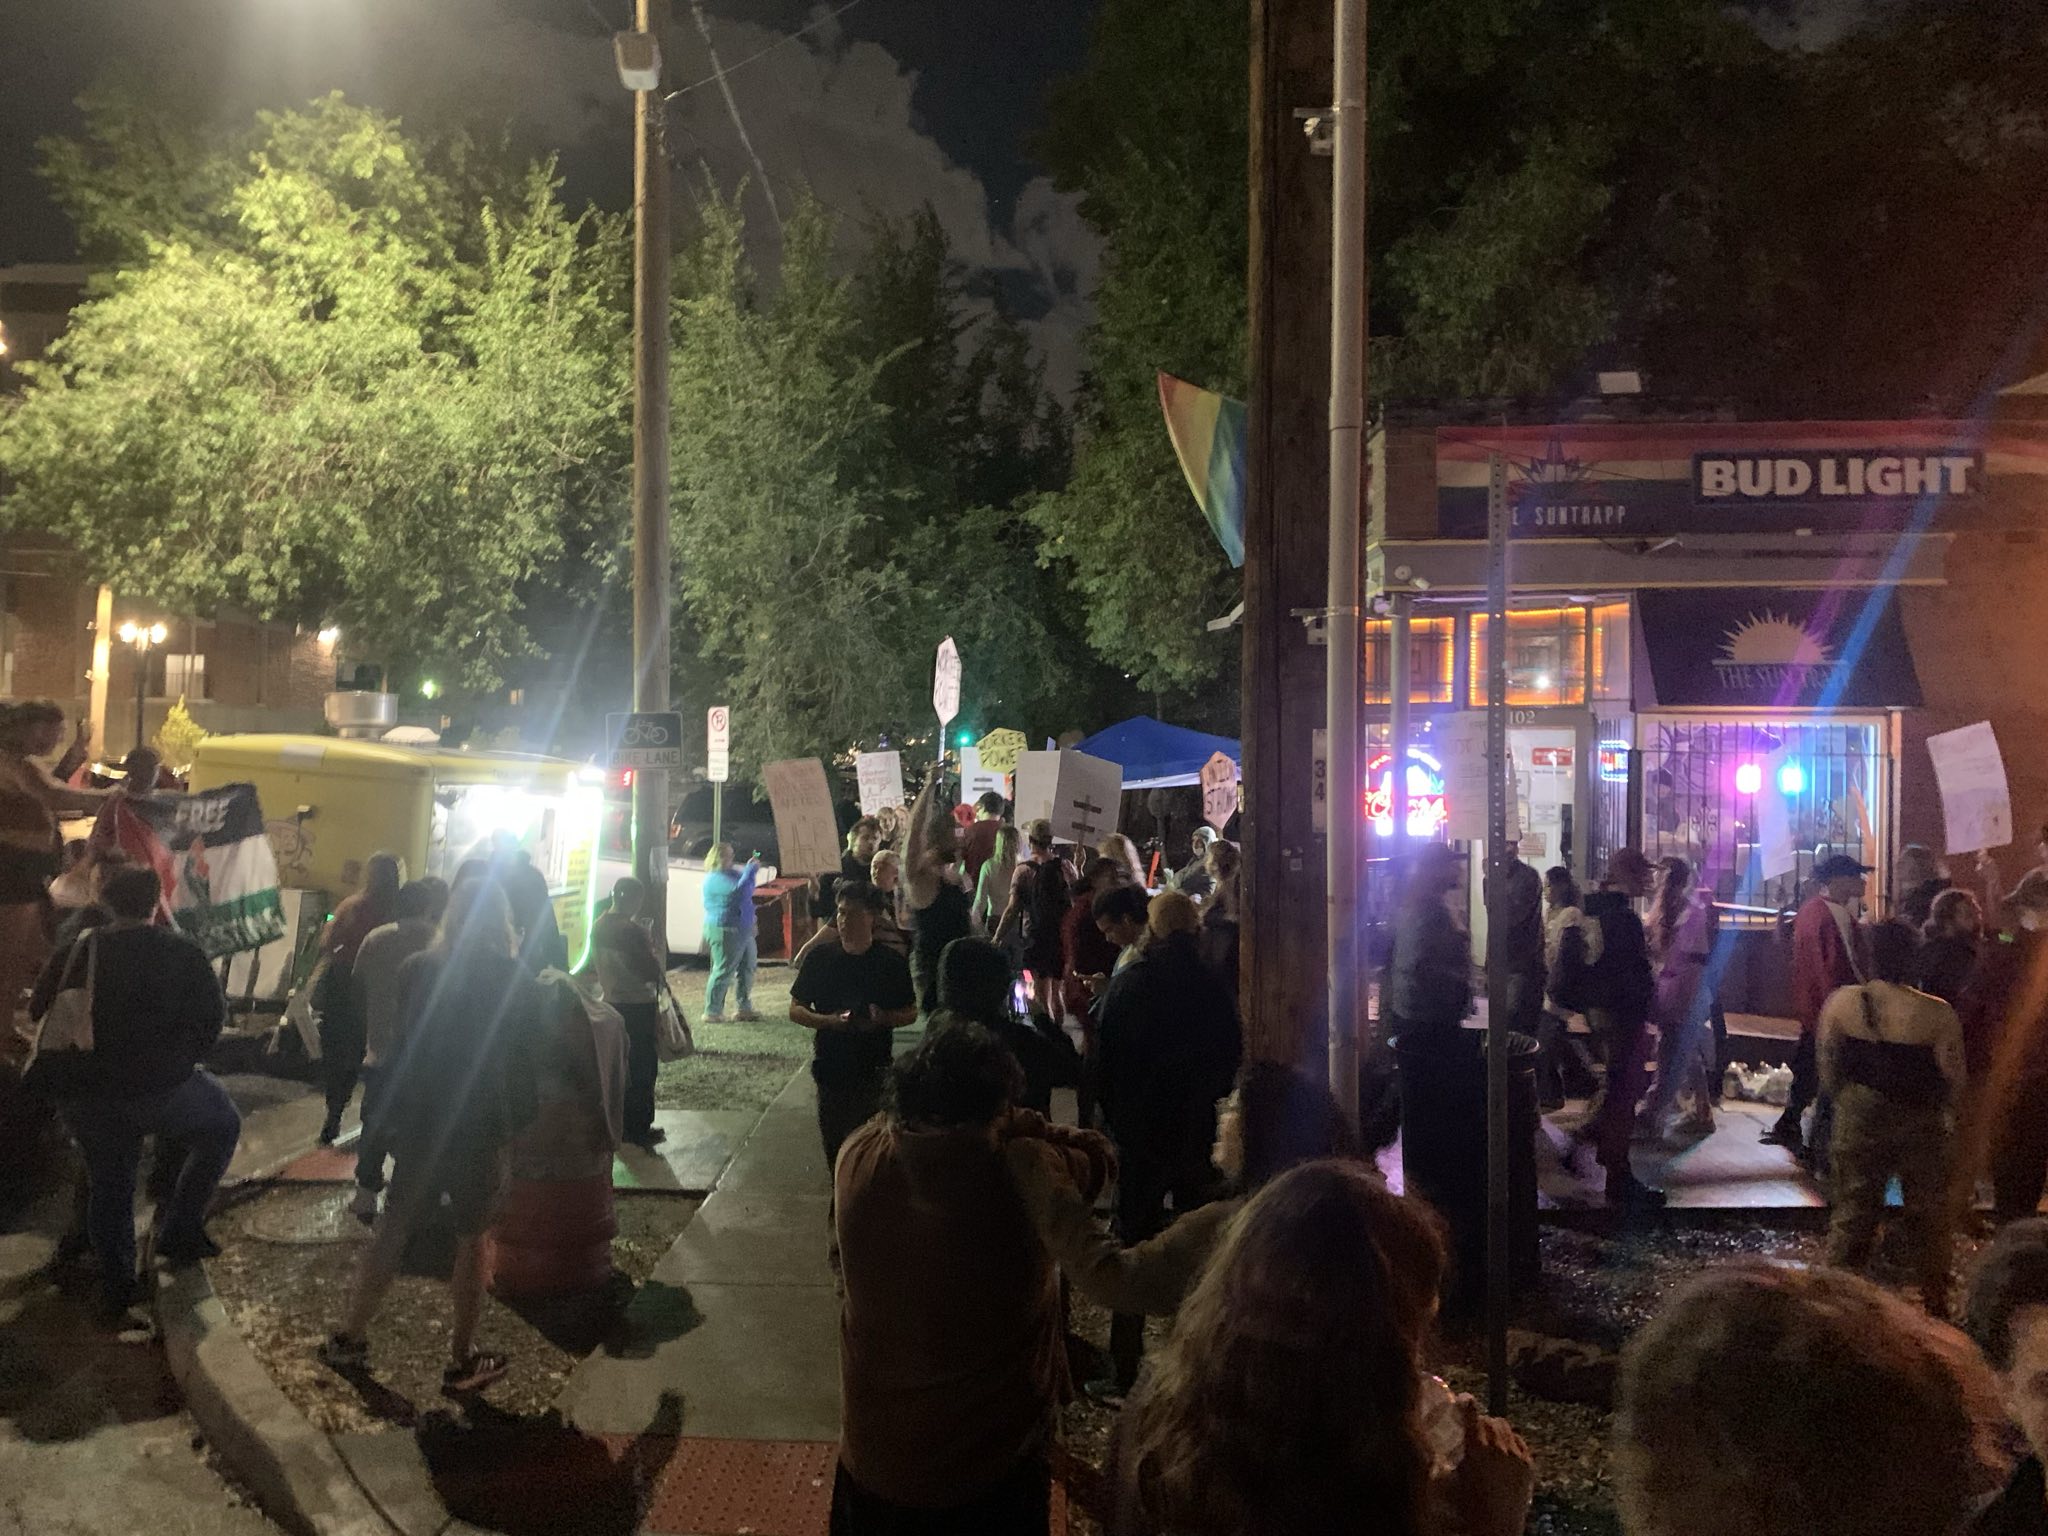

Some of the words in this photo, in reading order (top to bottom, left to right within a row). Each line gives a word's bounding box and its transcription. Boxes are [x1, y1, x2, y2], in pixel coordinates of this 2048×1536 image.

[1701, 459, 1812, 496] BUD
[1820, 457, 1974, 496] LIGHT
[1535, 505, 1626, 526] SUNTRAPP
[1715, 666, 1752, 689] THE
[612, 751, 640, 765] BIKE
[646, 750, 678, 765] LANE
[174, 797, 232, 833] FREE
